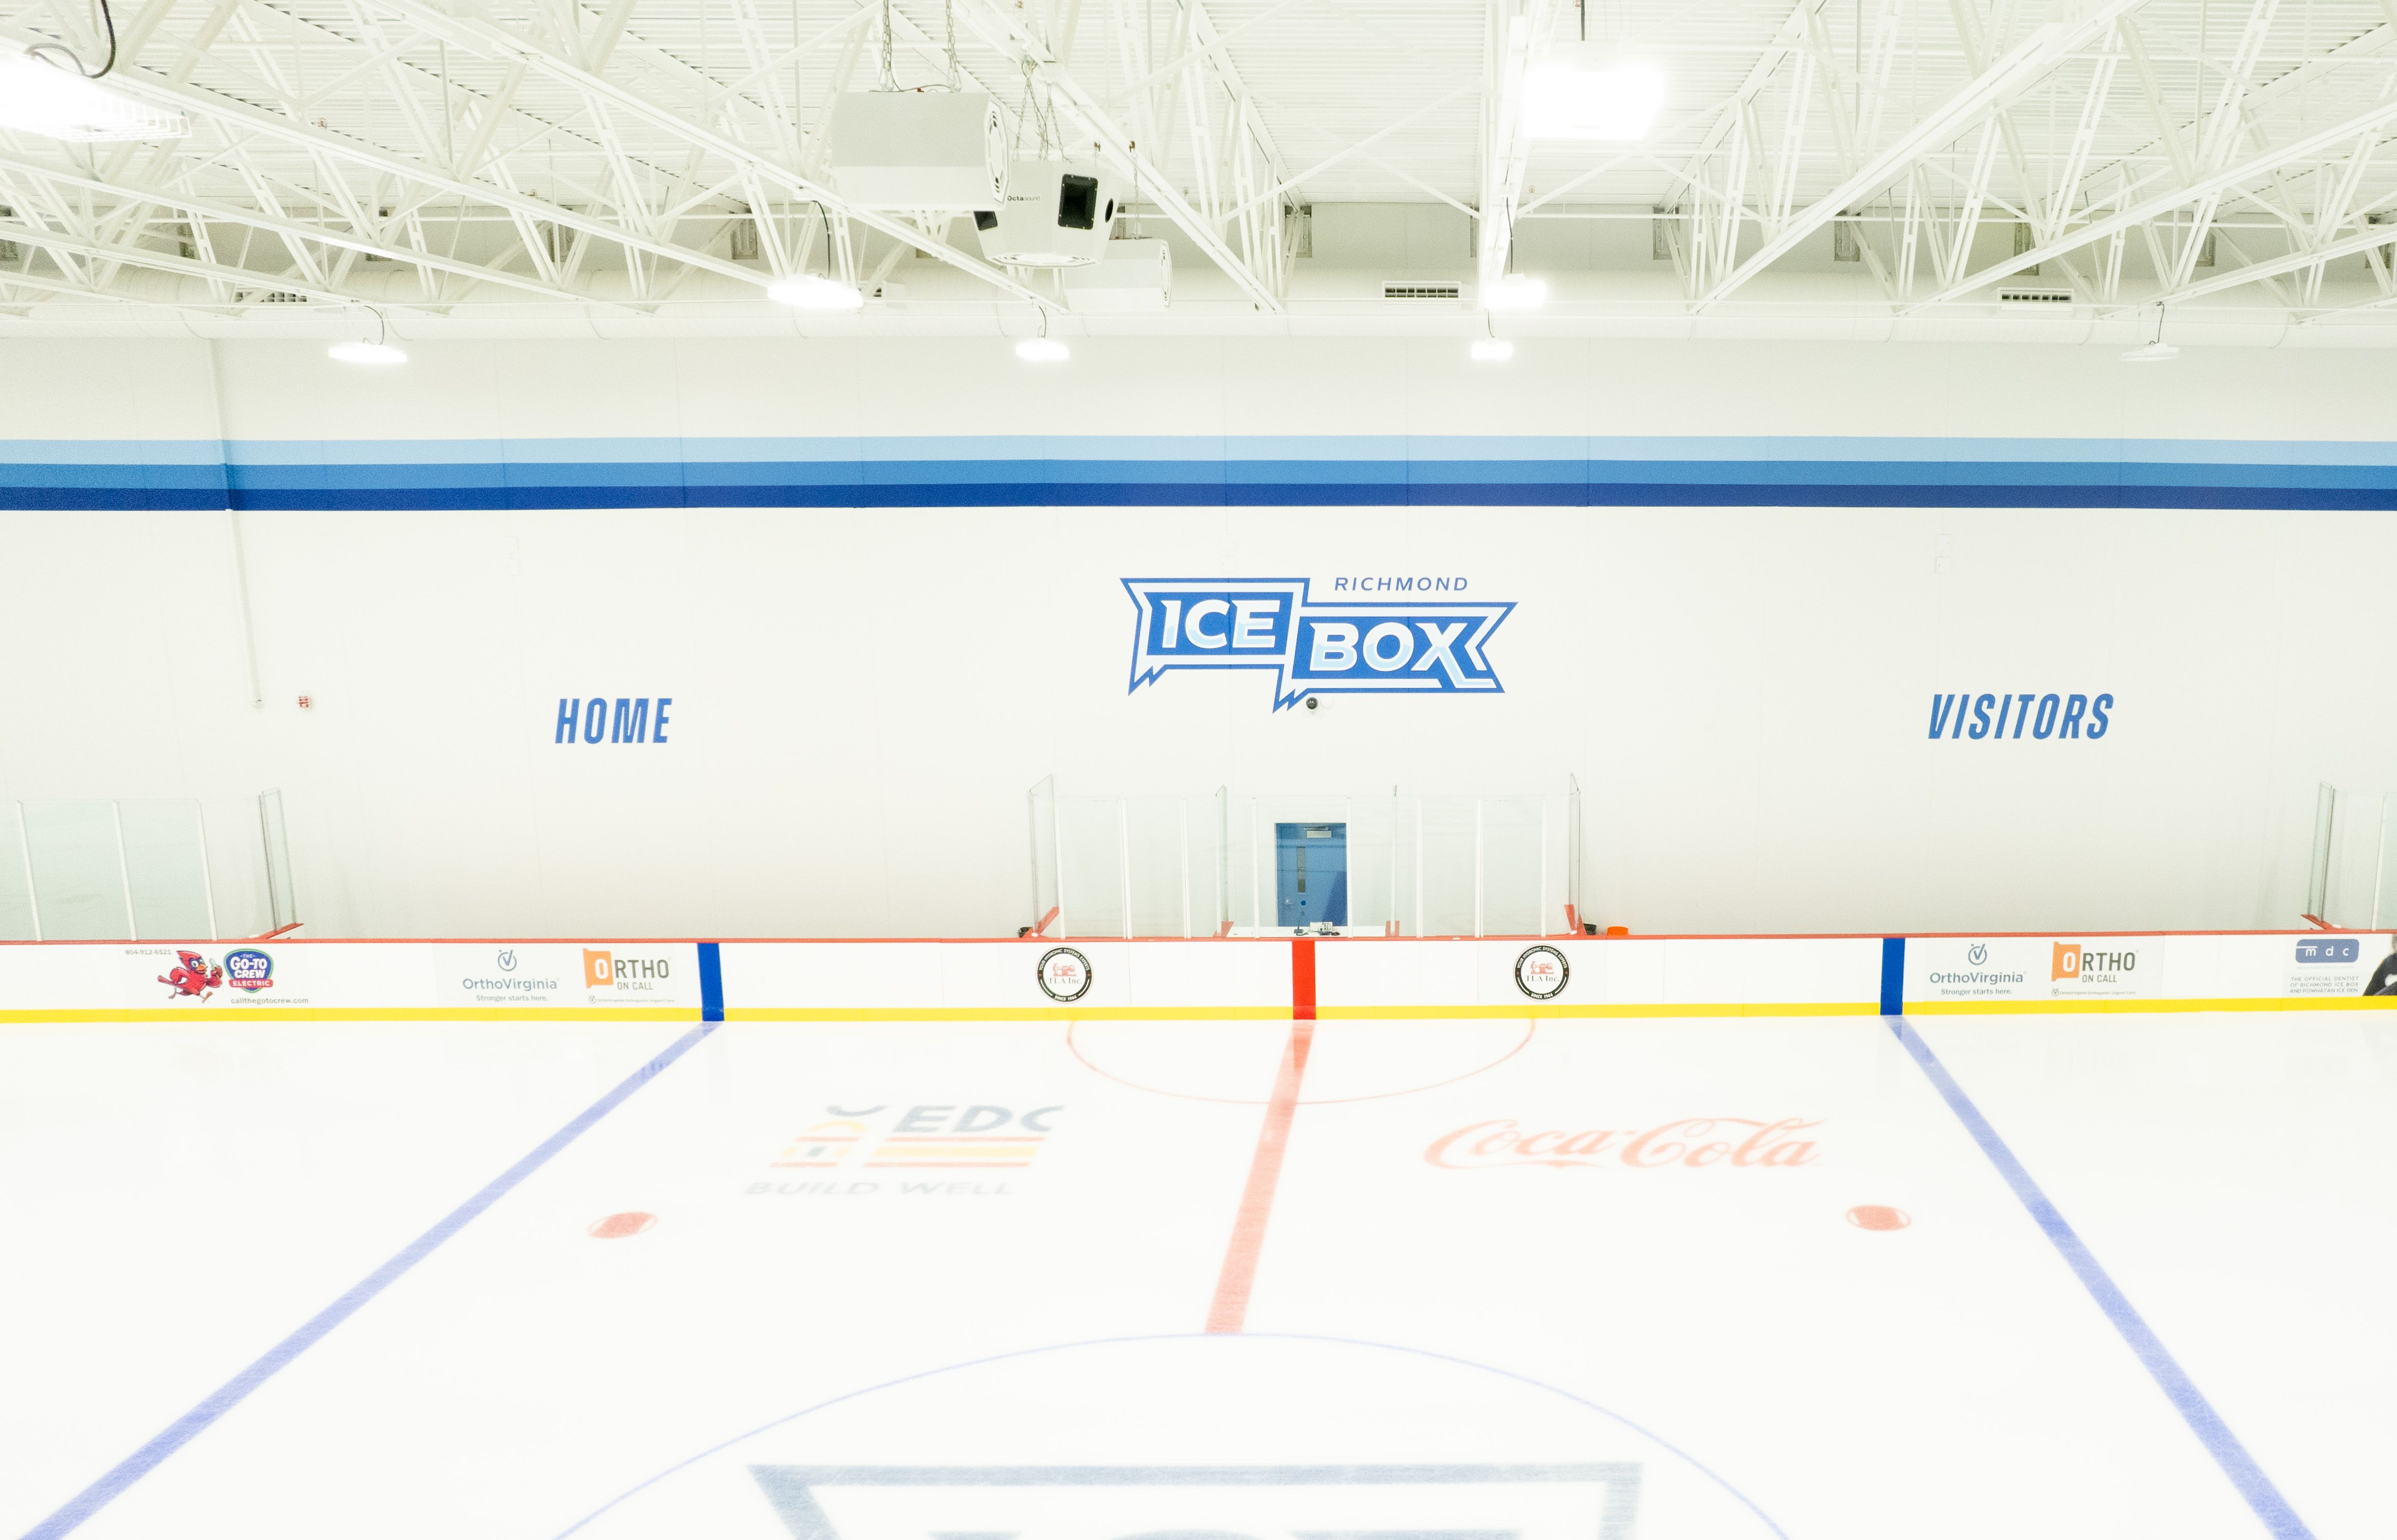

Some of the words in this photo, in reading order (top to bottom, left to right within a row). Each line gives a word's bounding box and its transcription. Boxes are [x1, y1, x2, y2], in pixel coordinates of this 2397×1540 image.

[1334, 577, 1469, 591] RICHMOND
[1160, 599, 1281, 649] ICE
[1310, 621, 1496, 688] BOX
[555, 698, 672, 744] HOME
[1928, 693, 2114, 739] VISITORS
[1064, 949, 1080, 957] SYSTEMS
[1542, 947, 1559, 955] SYSTEMS
[230, 956, 267, 970] GO-TO
[594, 958, 670, 979] ORTHO
[2062, 952, 2135, 972] ORTHO
[234, 970, 265, 978] CREW
[1930, 972, 2023, 985] OrthoVirginia
[2082, 975, 2093, 983] ON
[2097, 975, 2117, 983] CALL
[463, 978, 558, 991] OrthoVirginia
[617, 982, 627, 990] ON
[632, 982, 653, 990] CALL
[476, 994, 506, 1003] Stronger
[892, 1105, 1066, 1133] EDC
[1423, 1116, 1828, 1169] Coca-Cola
[743, 1181, 880, 1196] BUILD
[901, 1181, 1013, 1195] WELL
